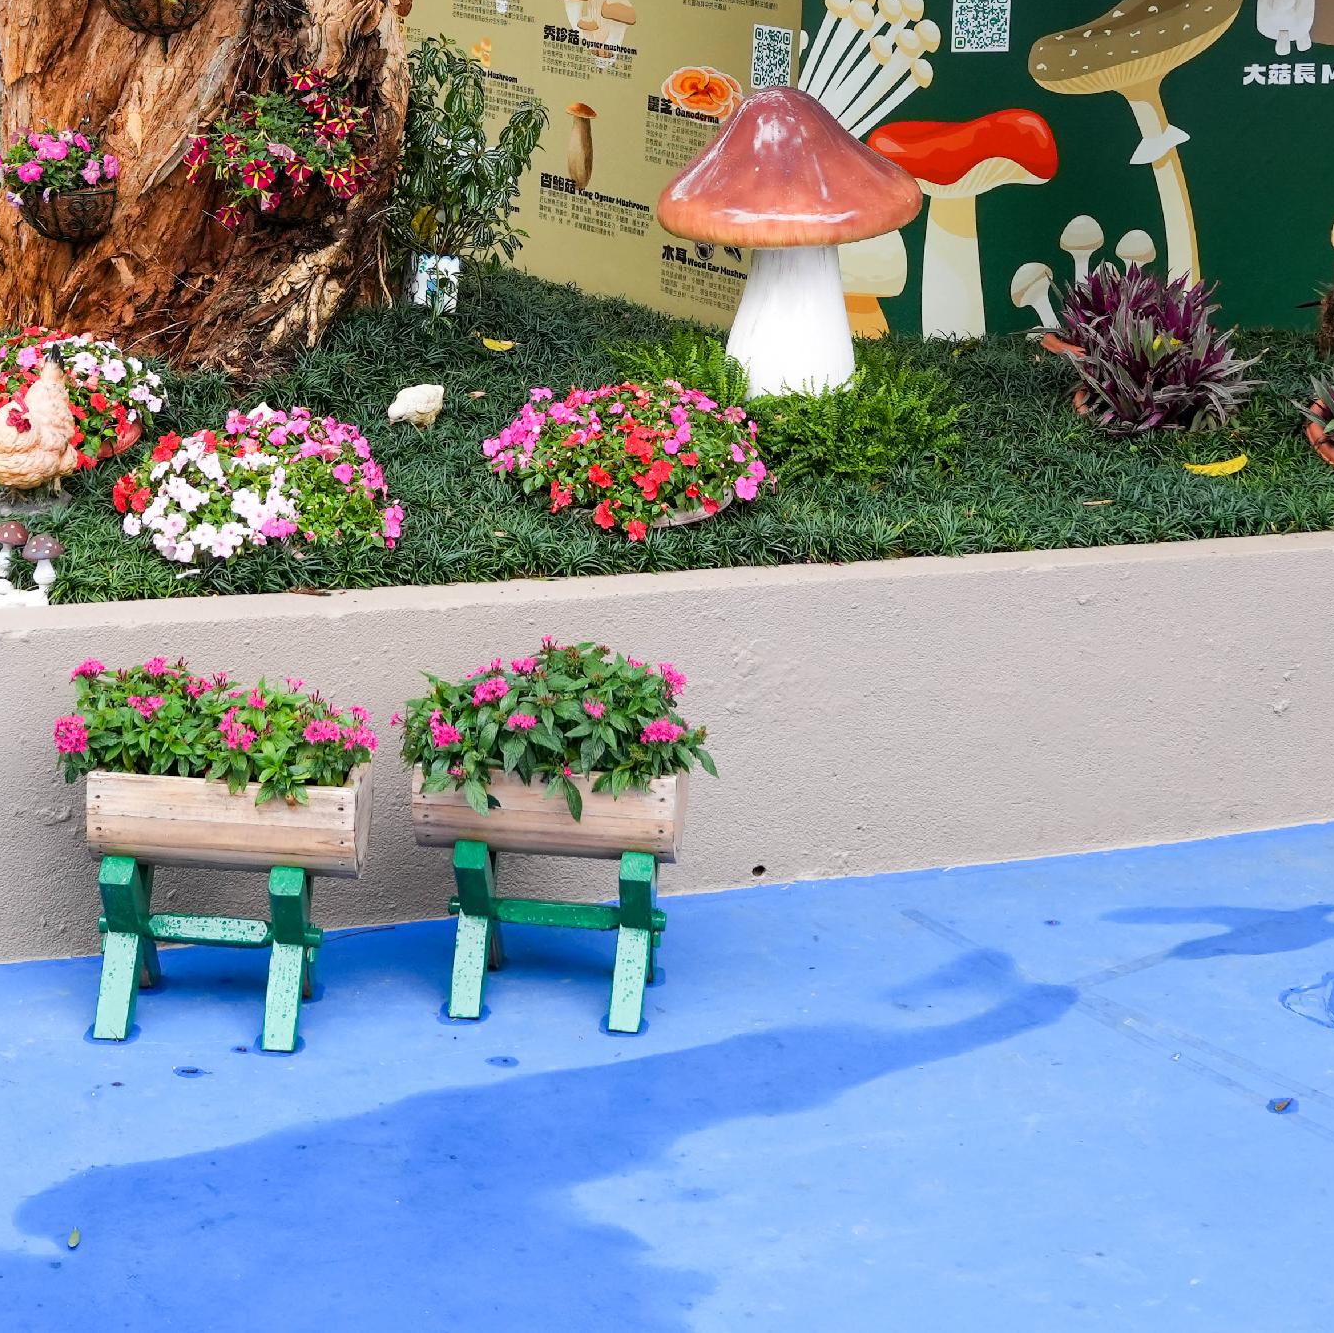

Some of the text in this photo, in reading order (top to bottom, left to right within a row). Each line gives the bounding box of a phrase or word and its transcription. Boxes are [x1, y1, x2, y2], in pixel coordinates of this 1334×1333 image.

[1242, 62, 1316, 86] 大菇長
[675, 107, 720, 125] Ganoderma
[661, 244, 688, 265] 木耳
[707, 262, 720, 274] Ear
